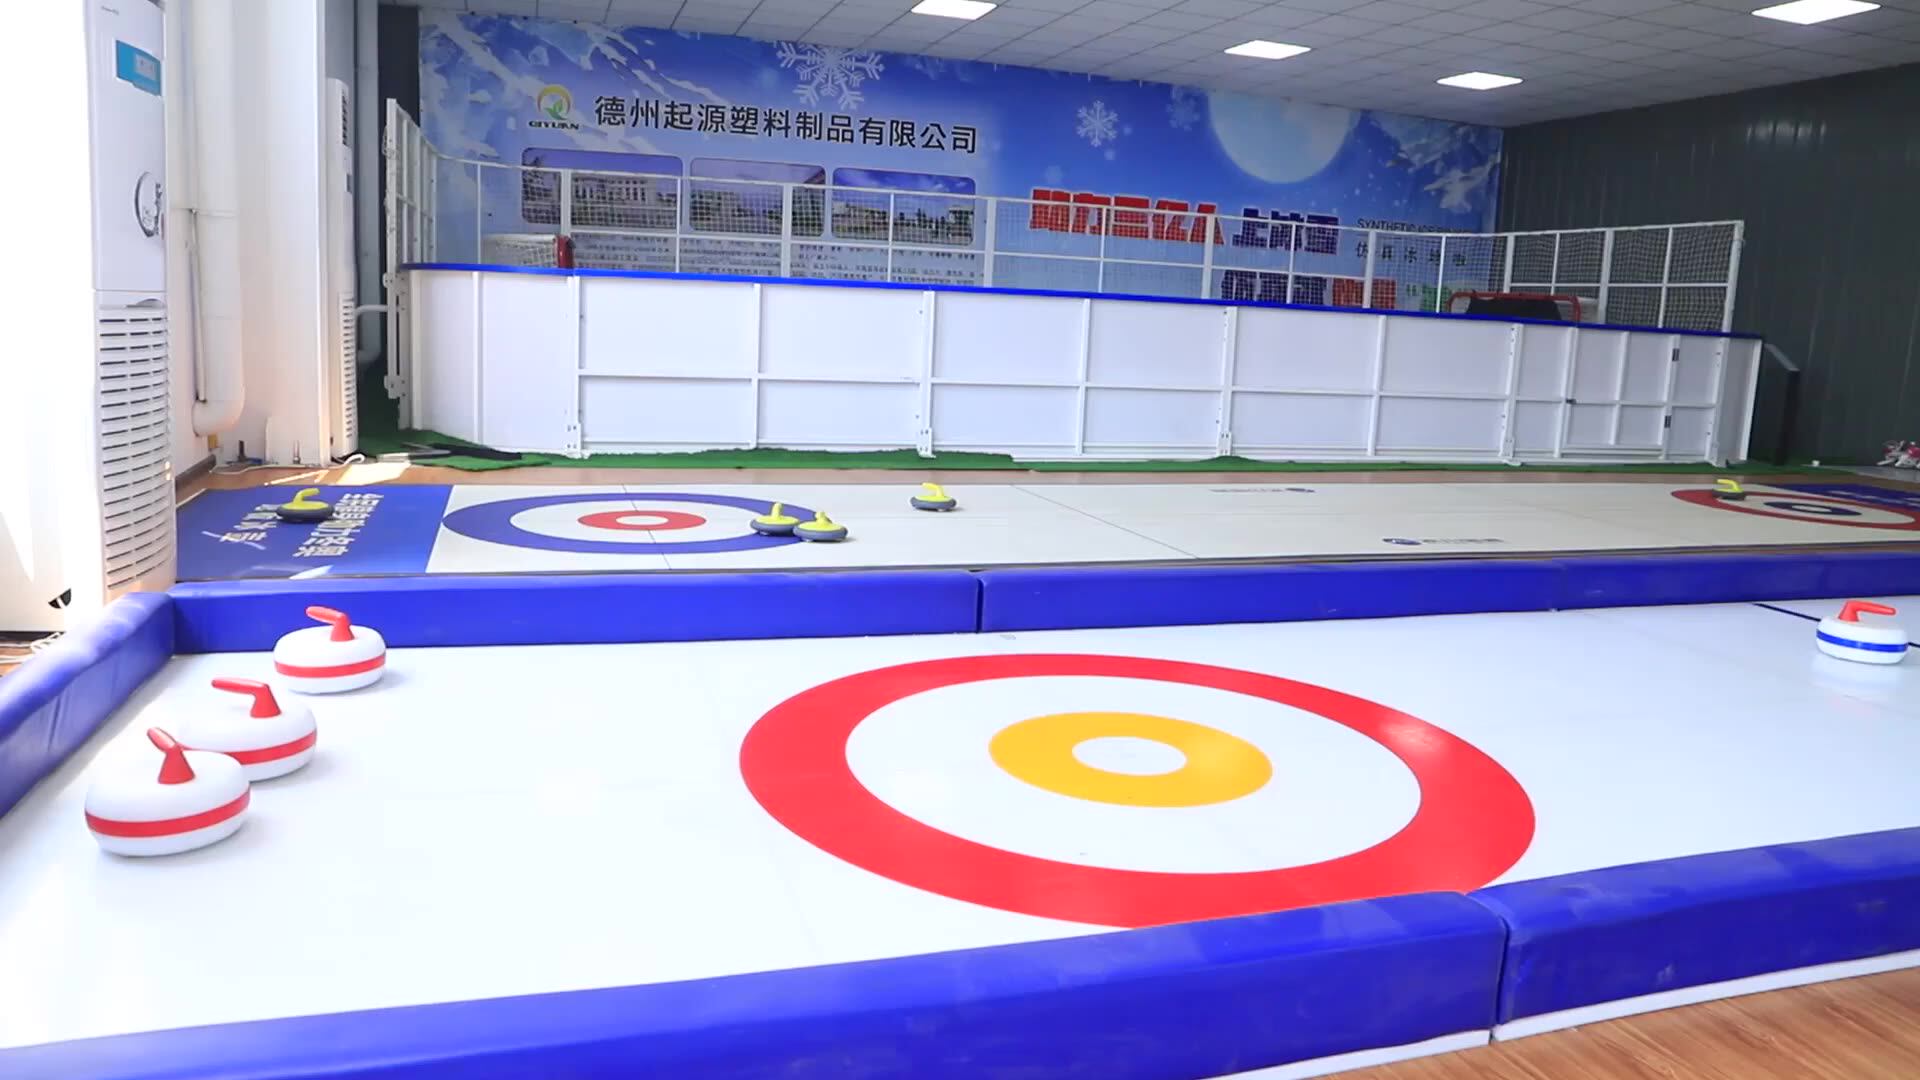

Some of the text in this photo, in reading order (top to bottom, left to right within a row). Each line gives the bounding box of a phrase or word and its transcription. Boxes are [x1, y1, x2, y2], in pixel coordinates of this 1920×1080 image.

[595, 95, 977, 154] 德州起源塑料制品有限公司
[1029, 187, 1225, 246] 助力三亿人
